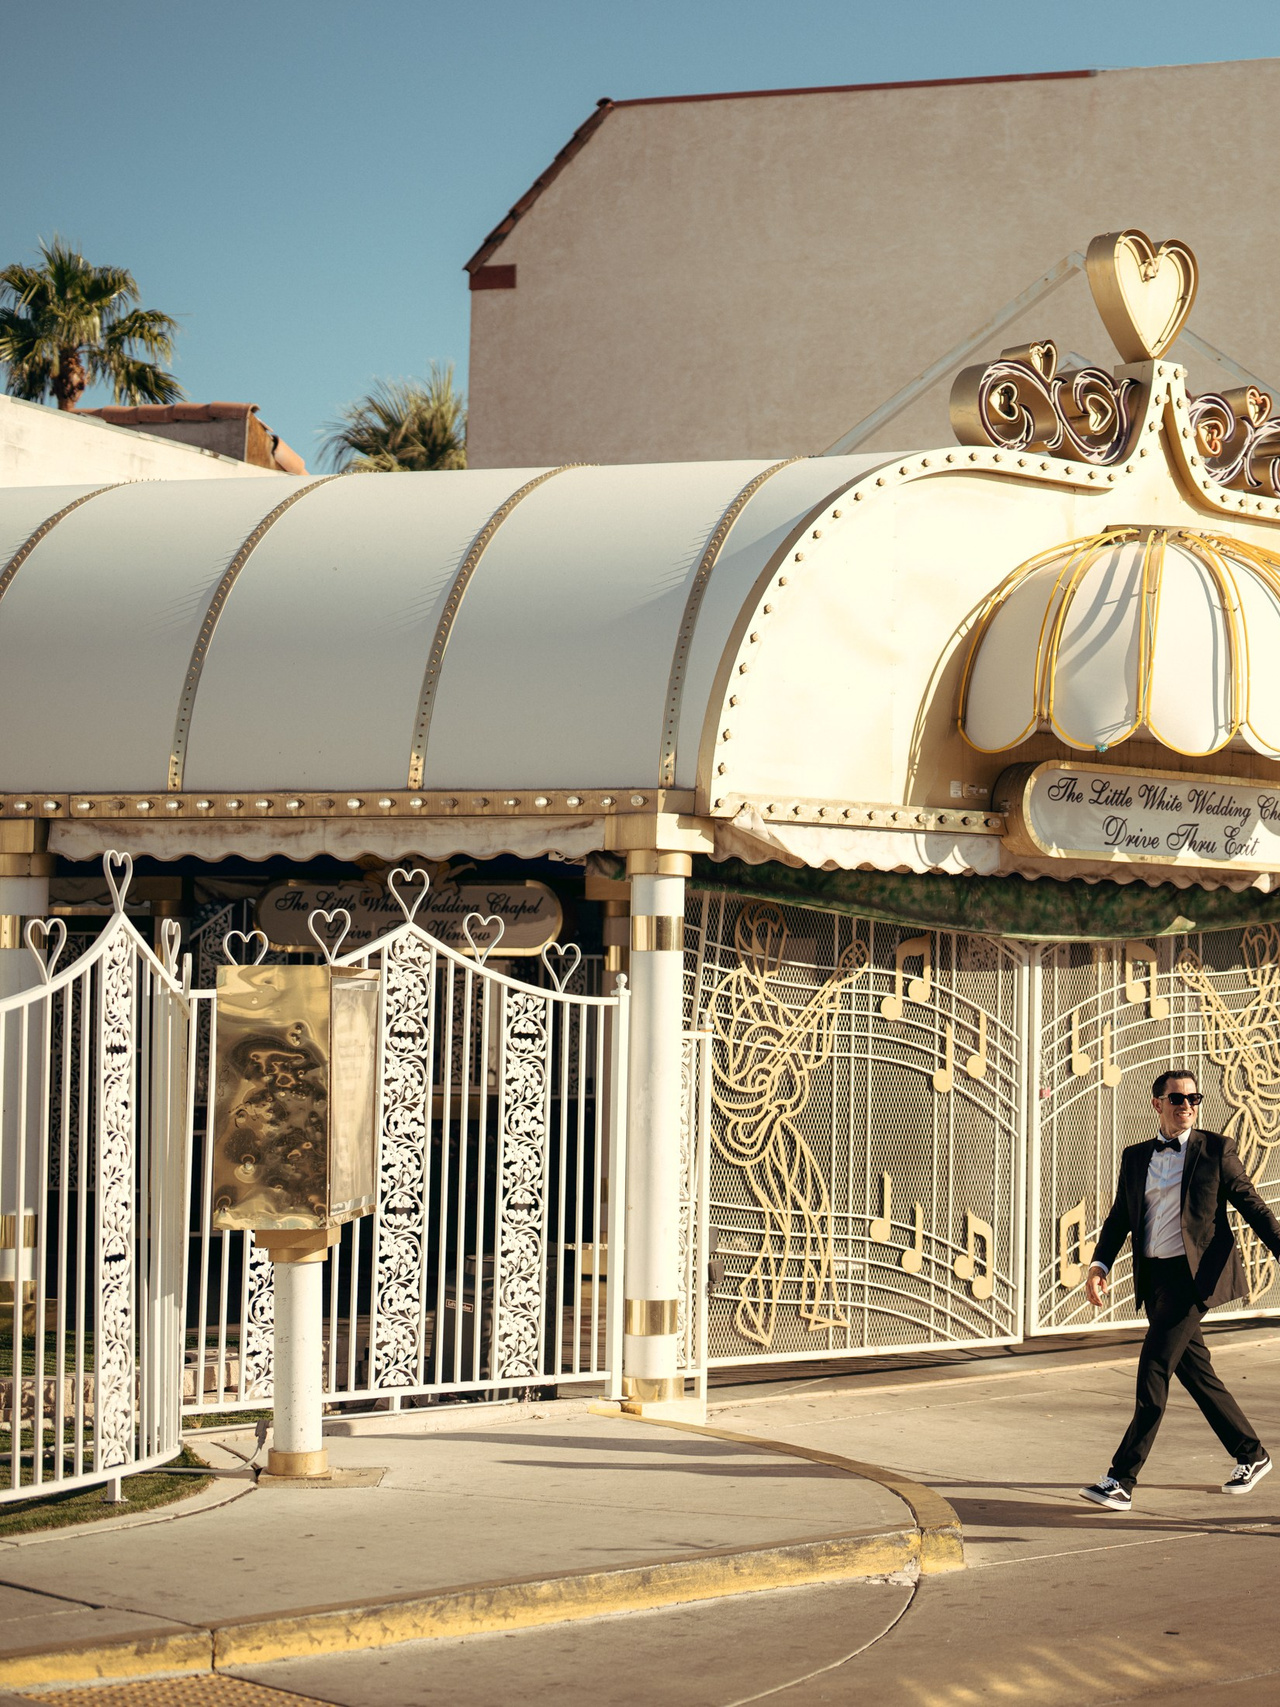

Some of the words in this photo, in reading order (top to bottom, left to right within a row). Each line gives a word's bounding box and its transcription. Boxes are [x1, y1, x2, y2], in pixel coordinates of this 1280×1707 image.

[1047, 777, 1084, 803] The
[1088, 779, 1133, 808] Little
[1137, 783, 1182, 812] White
[1187, 788, 1251, 827] Wedding
[1102, 815, 1160, 849] Drive
[1166, 823, 1217, 855] Thru
[1223, 825, 1260, 857] Exit
[275, 891, 309, 911] The
[314, 890, 357, 912] Little
[486, 892, 544, 920] Chapel
